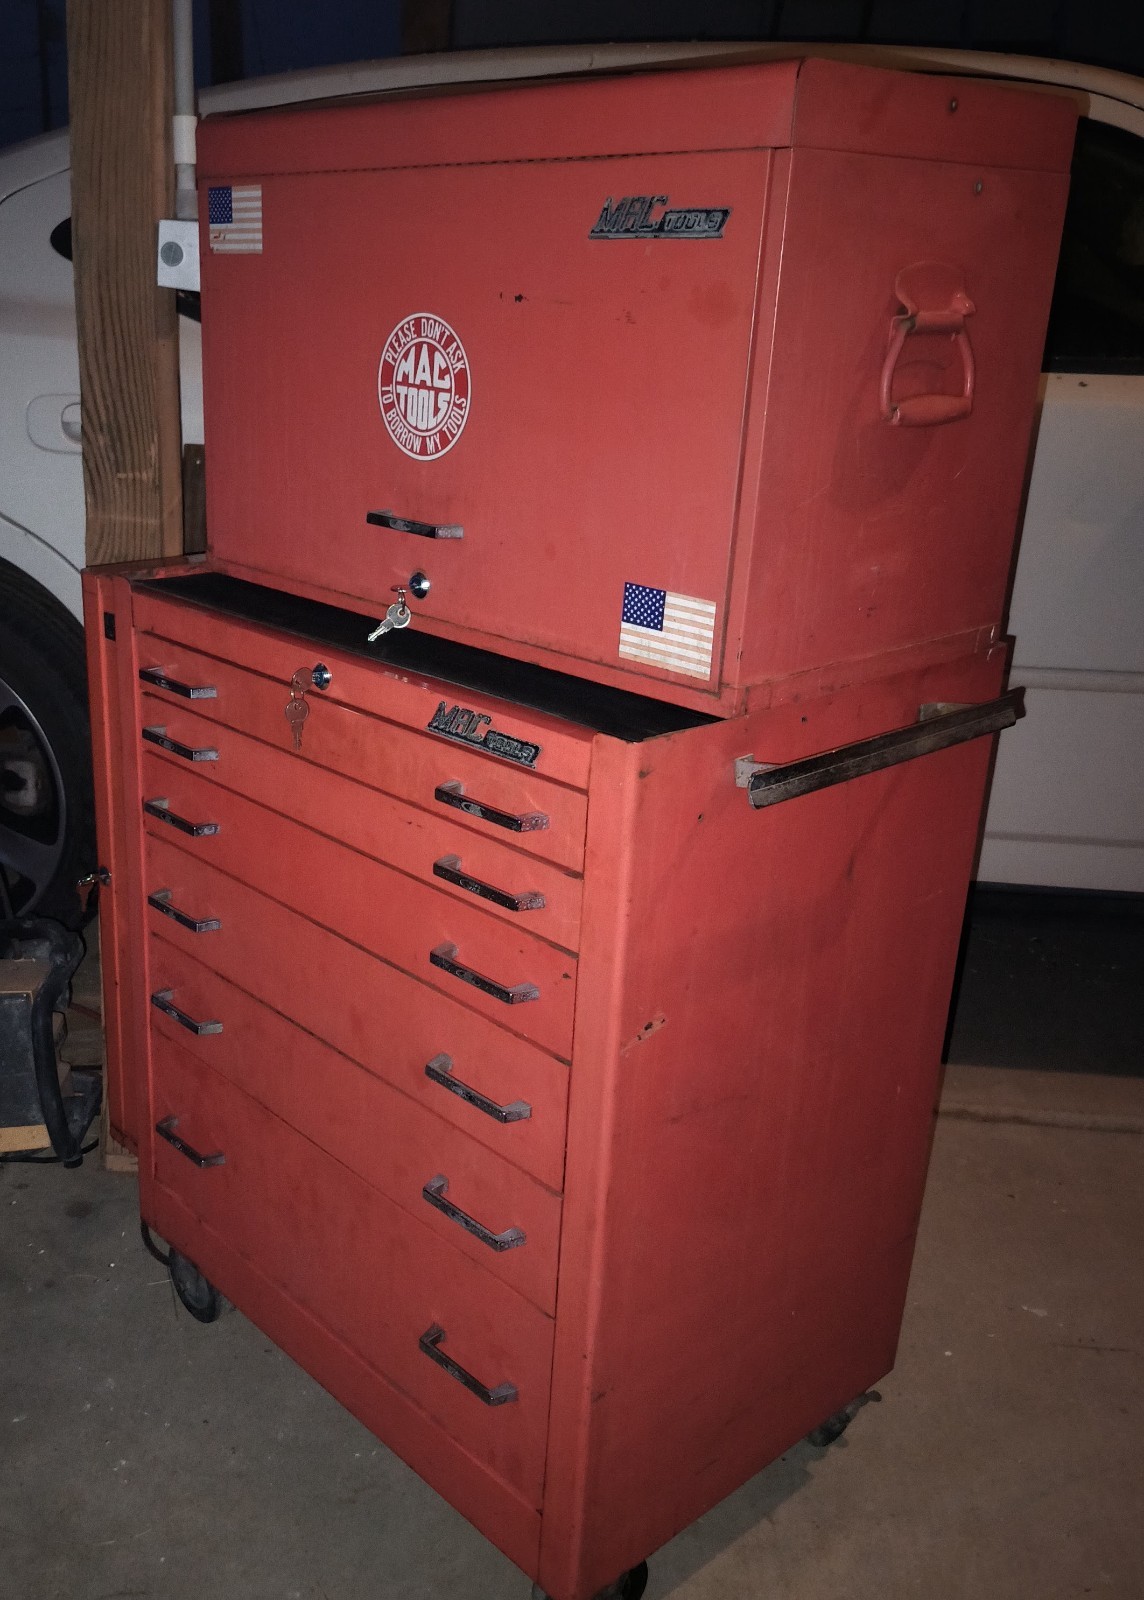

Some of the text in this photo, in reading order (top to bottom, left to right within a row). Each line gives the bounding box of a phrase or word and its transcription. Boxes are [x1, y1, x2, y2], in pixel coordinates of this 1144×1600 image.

[591, 195, 668, 232] MAC
[385, 318, 466, 374] PLEASE DON'T ASK
[396, 343, 451, 389] MAC
[381, 384, 467, 455] TO BORROW MY TOOLS
[396, 385, 451, 430] TOOLS
[429, 701, 492, 741] MAC
